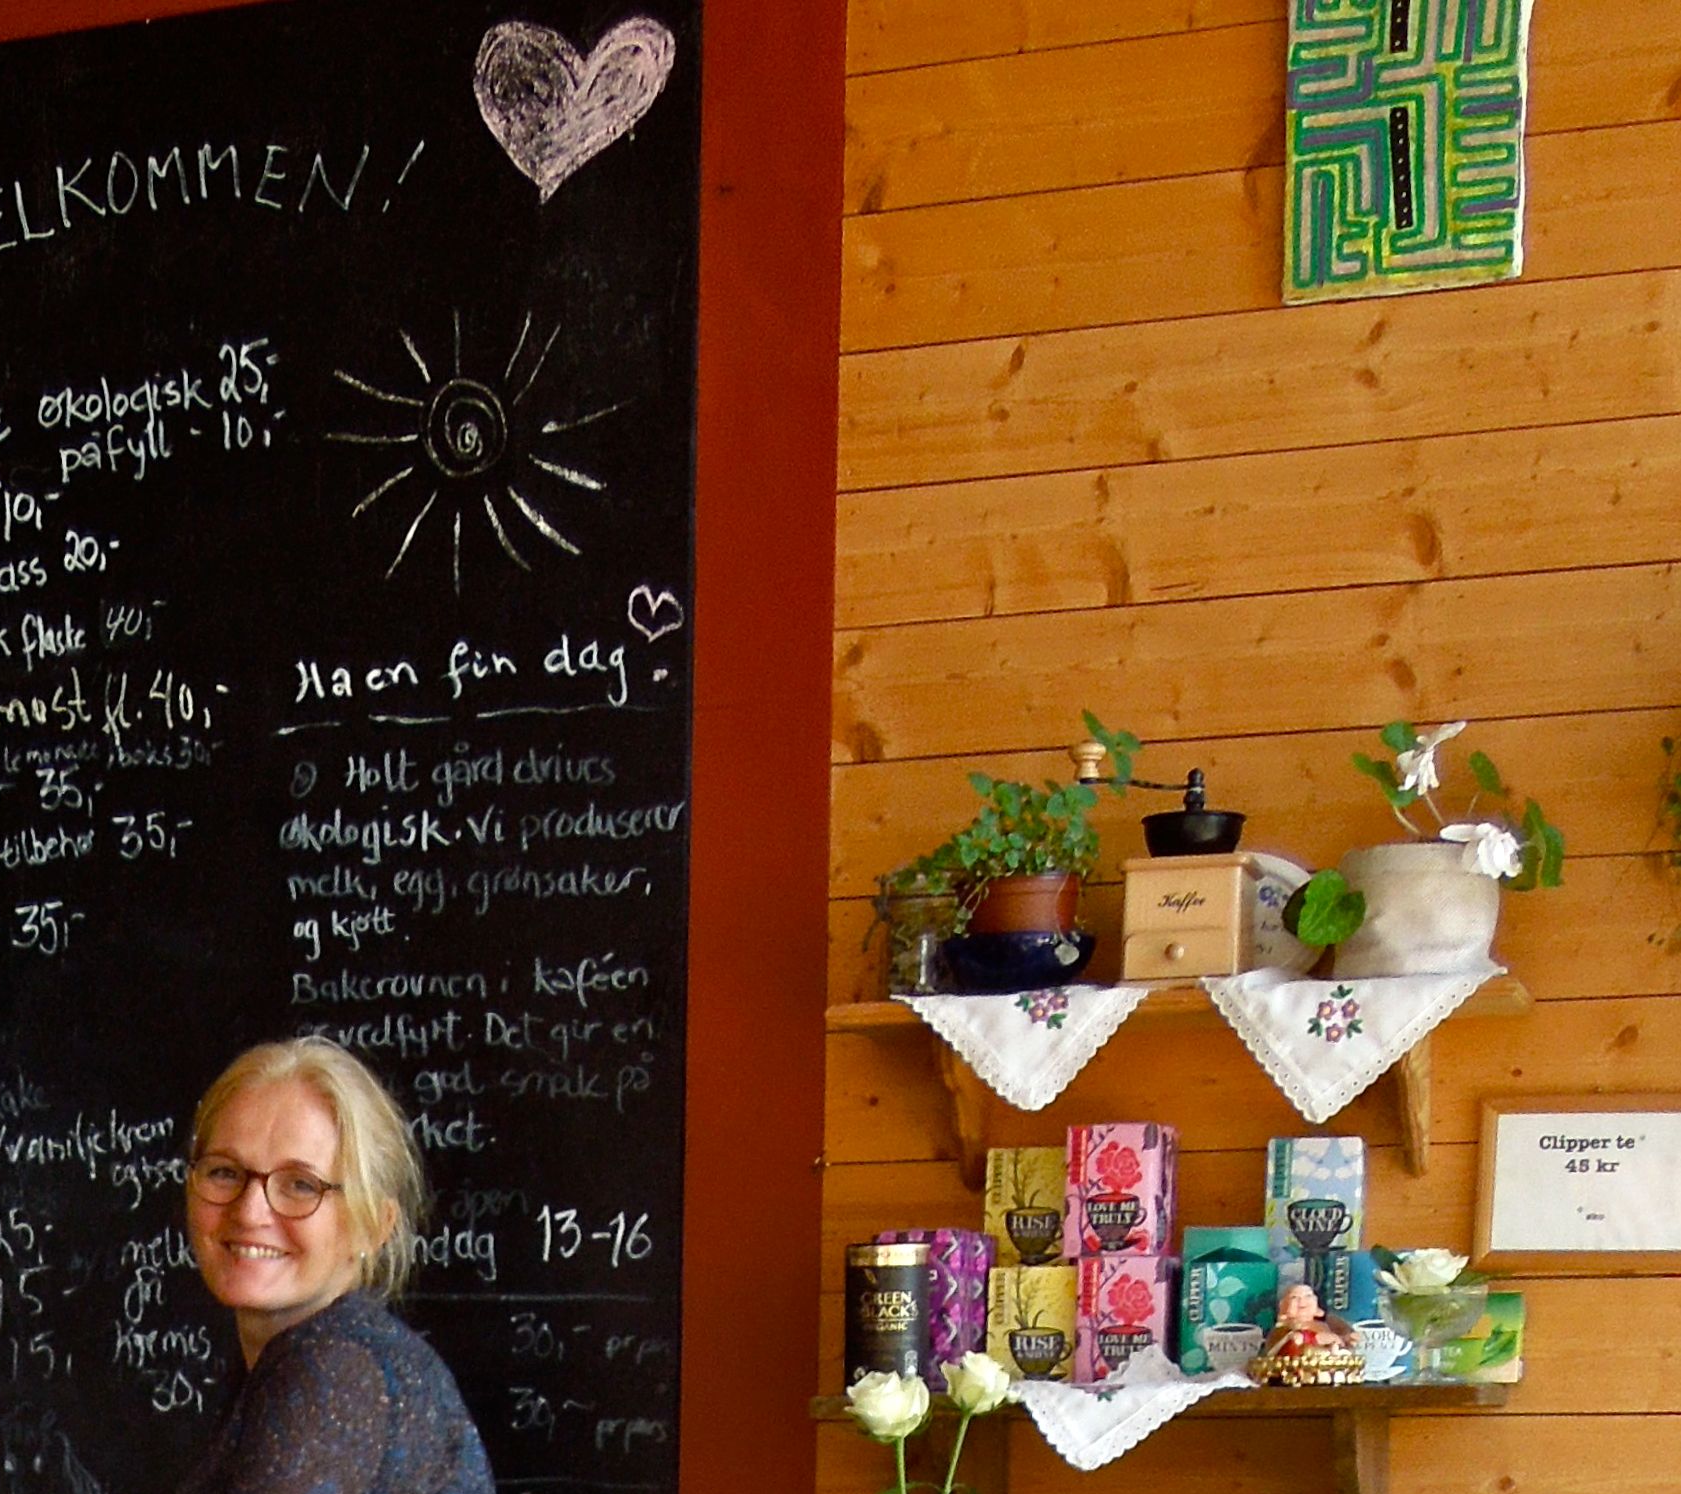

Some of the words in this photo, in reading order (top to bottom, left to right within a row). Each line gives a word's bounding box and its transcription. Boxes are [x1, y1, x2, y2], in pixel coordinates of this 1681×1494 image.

[60, 425, 172, 483] påfyll
[440, 640, 518, 699] fin
[345, 749, 419, 793] Holt
[431, 740, 504, 807] gård
[521, 802, 685, 851] produserer
[292, 918, 322, 961] og
[1539, 1135, 1611, 1152] Clipper
[1617, 1135, 1635, 1149] te
[1565, 1159, 1590, 1173] 45
[1596, 1159, 1620, 1173] kr
[1091, 1212, 1132, 1225] TRULY
[1290, 1207, 1343, 1221] CLOUD
[1295, 1219, 1338, 1232] NINE
[409, 1223, 497, 1282] ndag
[536, 1204, 652, 1268] 13-16
[1333, 1255, 1348, 1310] CLIPPER
[1208, 1341, 1259, 1353] MINTS
